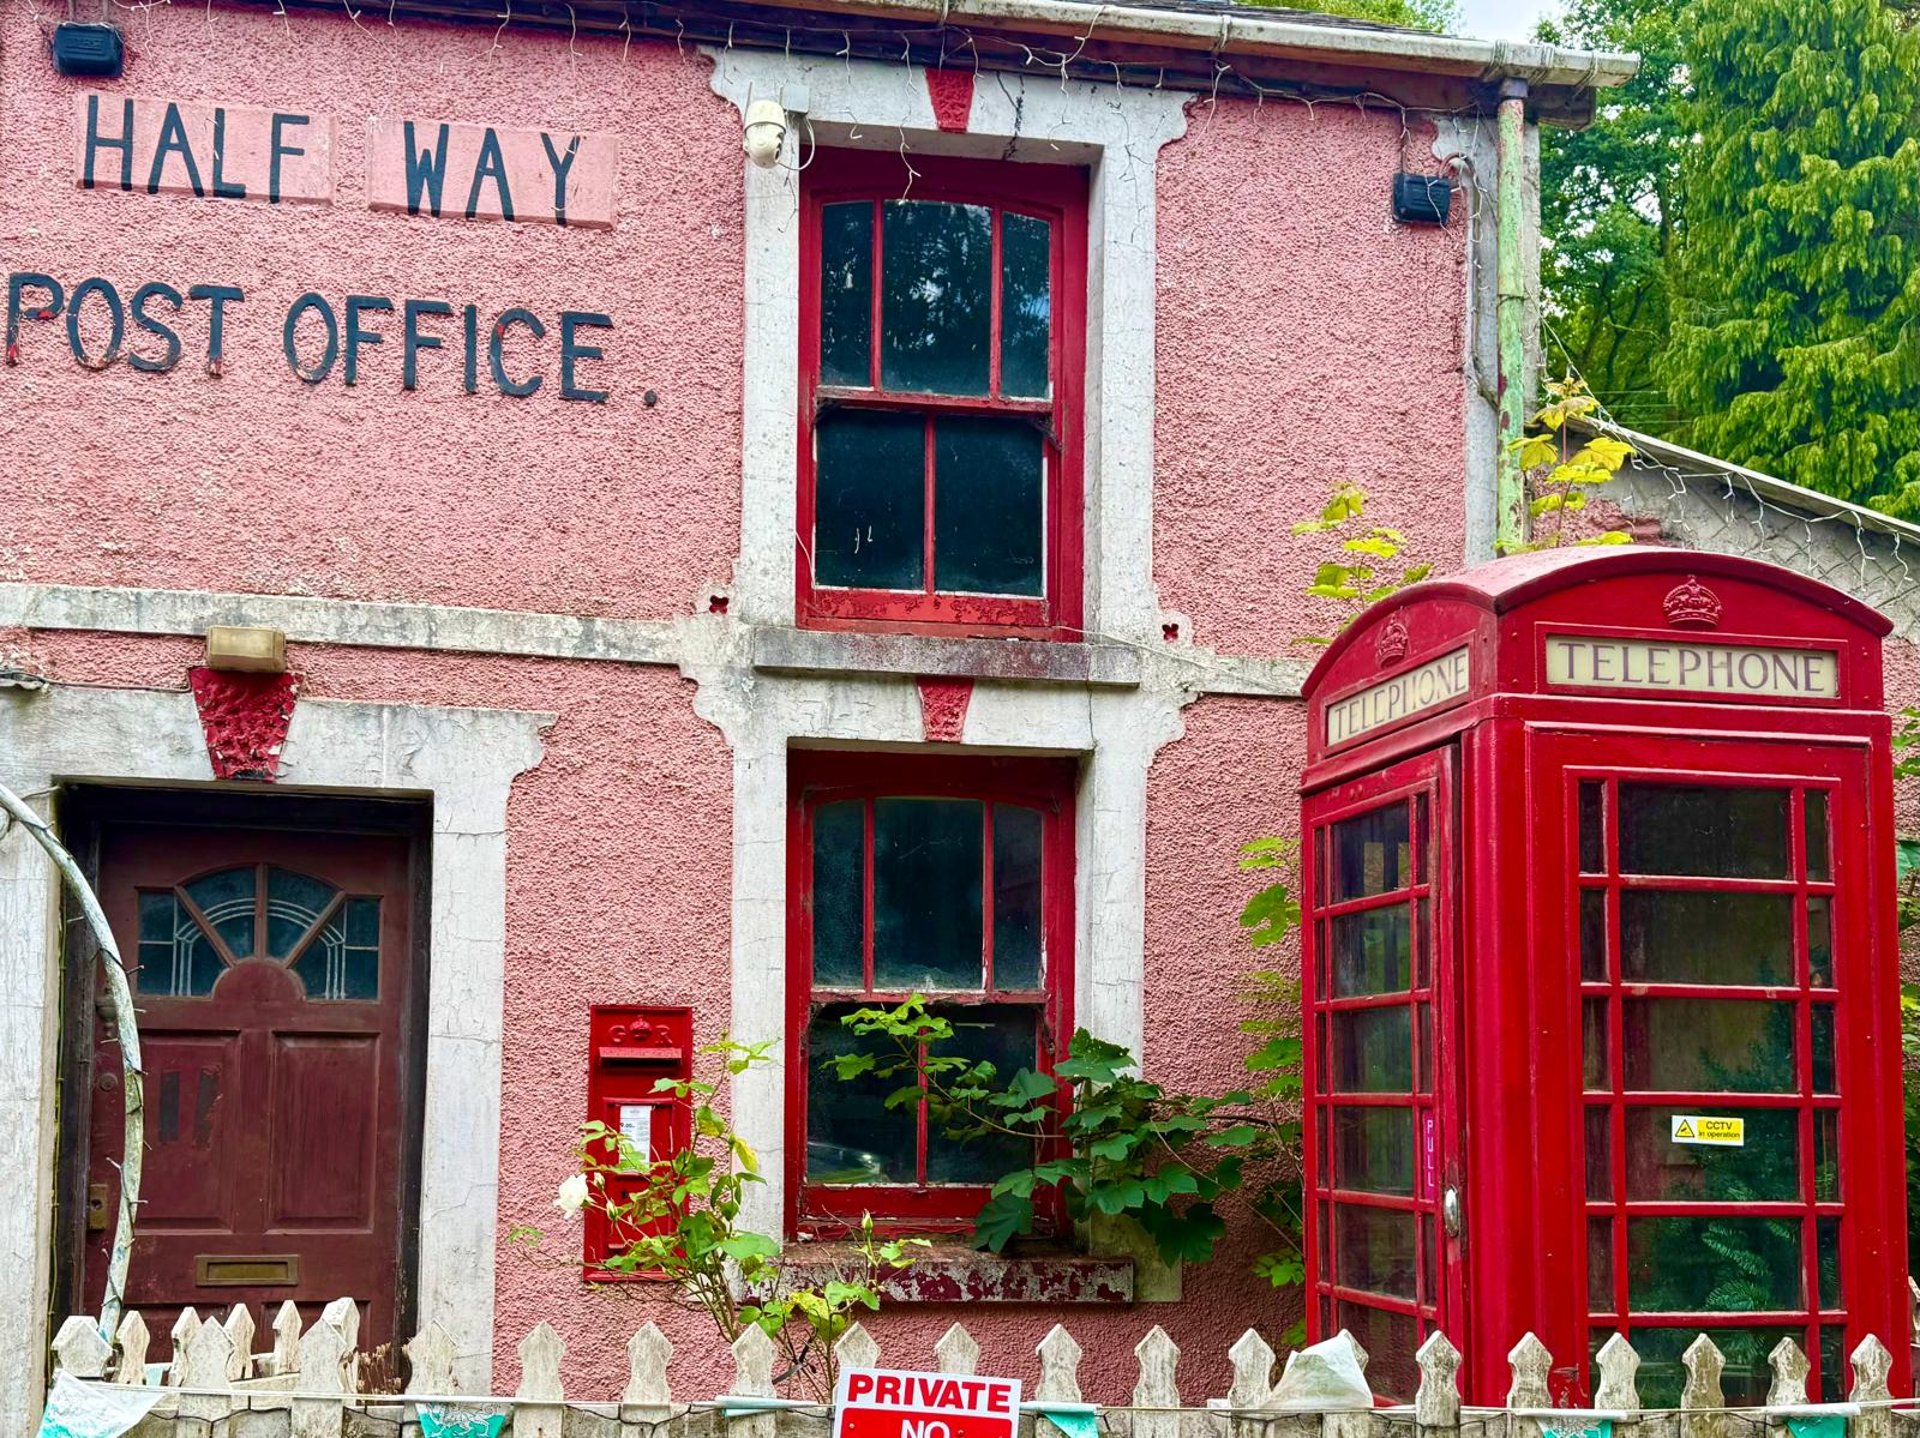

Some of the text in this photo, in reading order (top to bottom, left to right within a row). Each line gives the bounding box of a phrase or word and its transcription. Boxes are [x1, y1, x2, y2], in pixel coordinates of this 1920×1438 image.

[84, 95, 581, 226] HALF WAY
[5, 272, 245, 378] POST
[1557, 641, 1826, 692] TELEPHONE
[1333, 650, 1468, 740] TELEPHONE
[1705, 1120, 1733, 1131] CCTV
[1706, 1131, 1741, 1140] operation
[1427, 1119, 1435, 1188] PULL
[847, 1373, 1012, 1414] PRIVATE
[901, 1418, 950, 1438] NO
